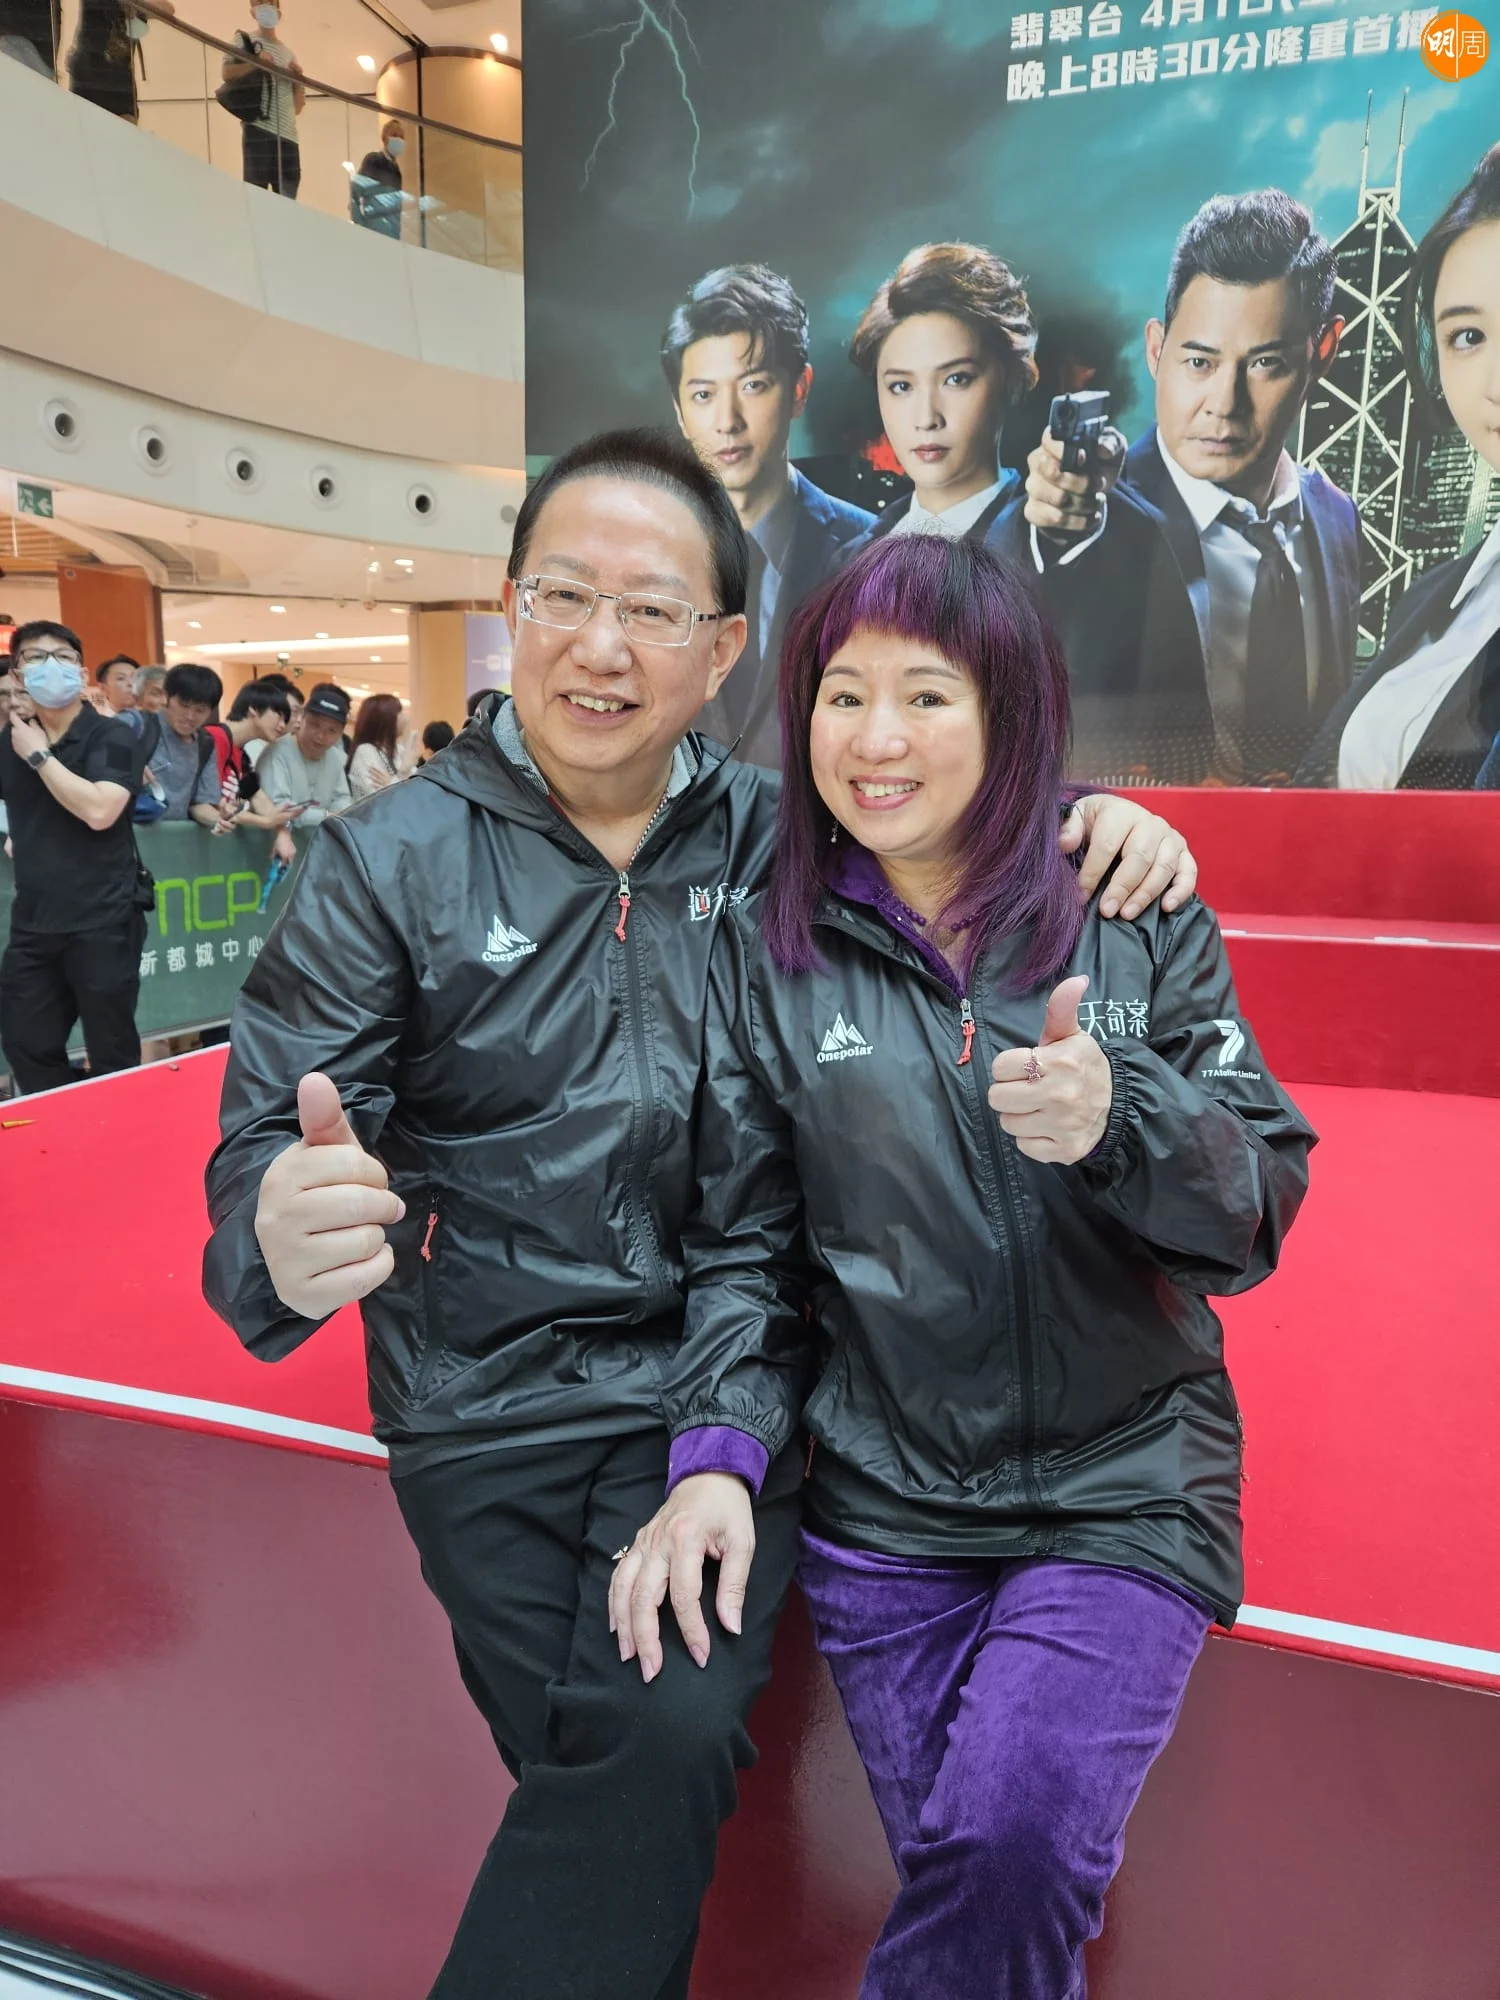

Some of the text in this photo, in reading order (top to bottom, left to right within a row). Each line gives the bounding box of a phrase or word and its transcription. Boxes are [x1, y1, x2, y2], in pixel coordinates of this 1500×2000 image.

[1010, 1, 1122, 49] 翡翠台
[482, 942, 538, 962] Onepolar
[816, 1045, 874, 1064] Onepolar
